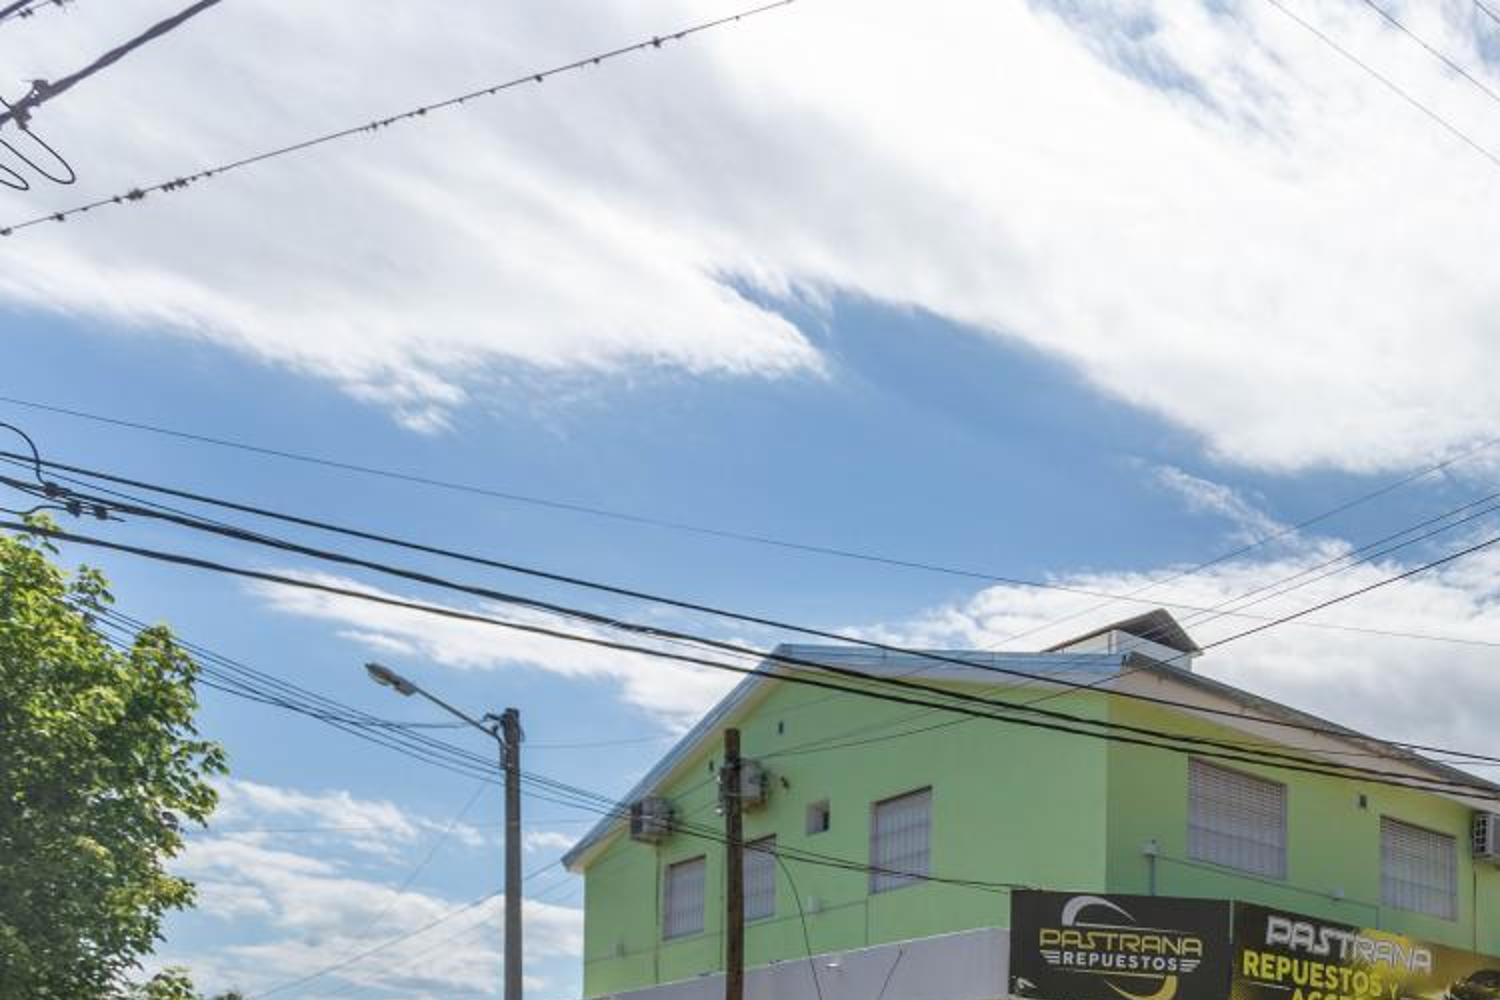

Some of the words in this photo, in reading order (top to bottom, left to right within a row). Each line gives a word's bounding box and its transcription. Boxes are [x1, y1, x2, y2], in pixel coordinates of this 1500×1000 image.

[1039, 928, 1203, 957] PASTRANA
[1063, 951, 1178, 971] REPUESTOS
[1266, 916, 1432, 972] PASTRANA
[1243, 949, 1383, 997] REPUESTOS
